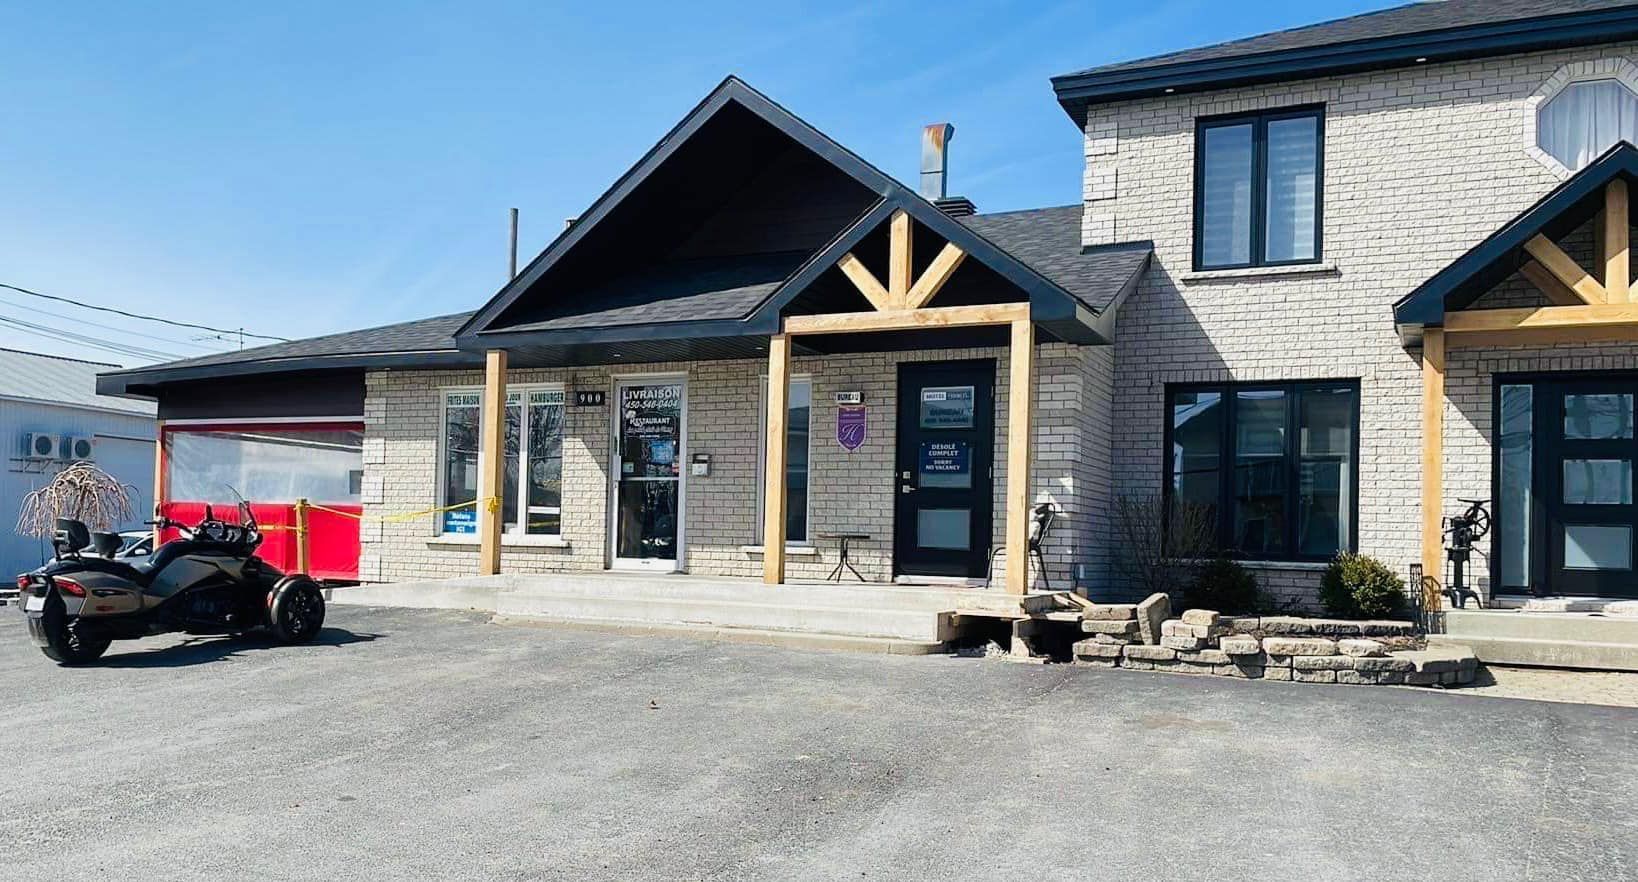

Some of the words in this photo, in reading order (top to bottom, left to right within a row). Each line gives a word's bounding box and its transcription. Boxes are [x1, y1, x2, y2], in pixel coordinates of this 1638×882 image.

[530, 391, 564, 403] HAMBURGER
[623, 386, 680, 399] LIVRAISON
[837, 393, 859, 401] BUREAU
[462, 394, 480, 405] MAISON
[580, 393, 601, 403] 900
[629, 417, 671, 427] RESTAURANT
